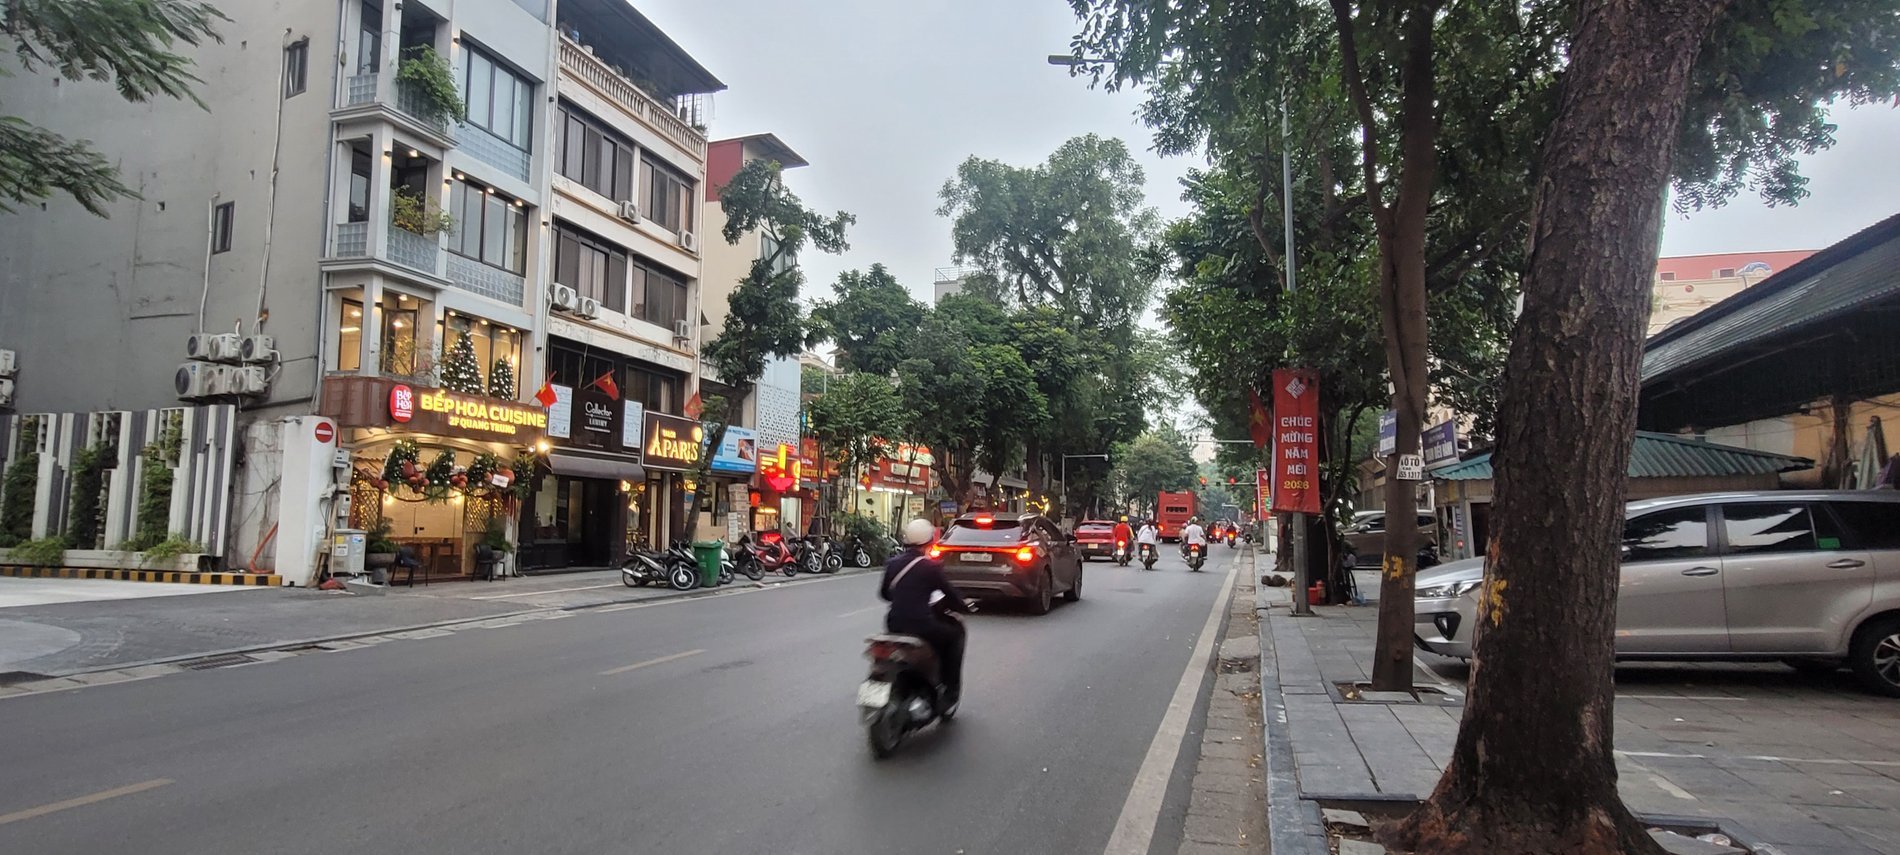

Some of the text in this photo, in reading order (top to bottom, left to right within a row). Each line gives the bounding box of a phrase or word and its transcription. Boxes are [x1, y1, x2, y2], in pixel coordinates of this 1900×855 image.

[420, 389, 455, 413] BẾP
[455, 400, 489, 419] HOA
[489, 406, 547, 428] CUISINE
[461, 418, 490, 431] QUANG
[490, 421, 516, 435] TRUNG
[1281, 414, 1313, 427] CHÚC
[1281, 430, 1313, 443] MỪNG
[1285, 447, 1309, 459] NĂM
[1287, 462, 1307, 475] MỚI
[1283, 480, 1310, 490] 2026
